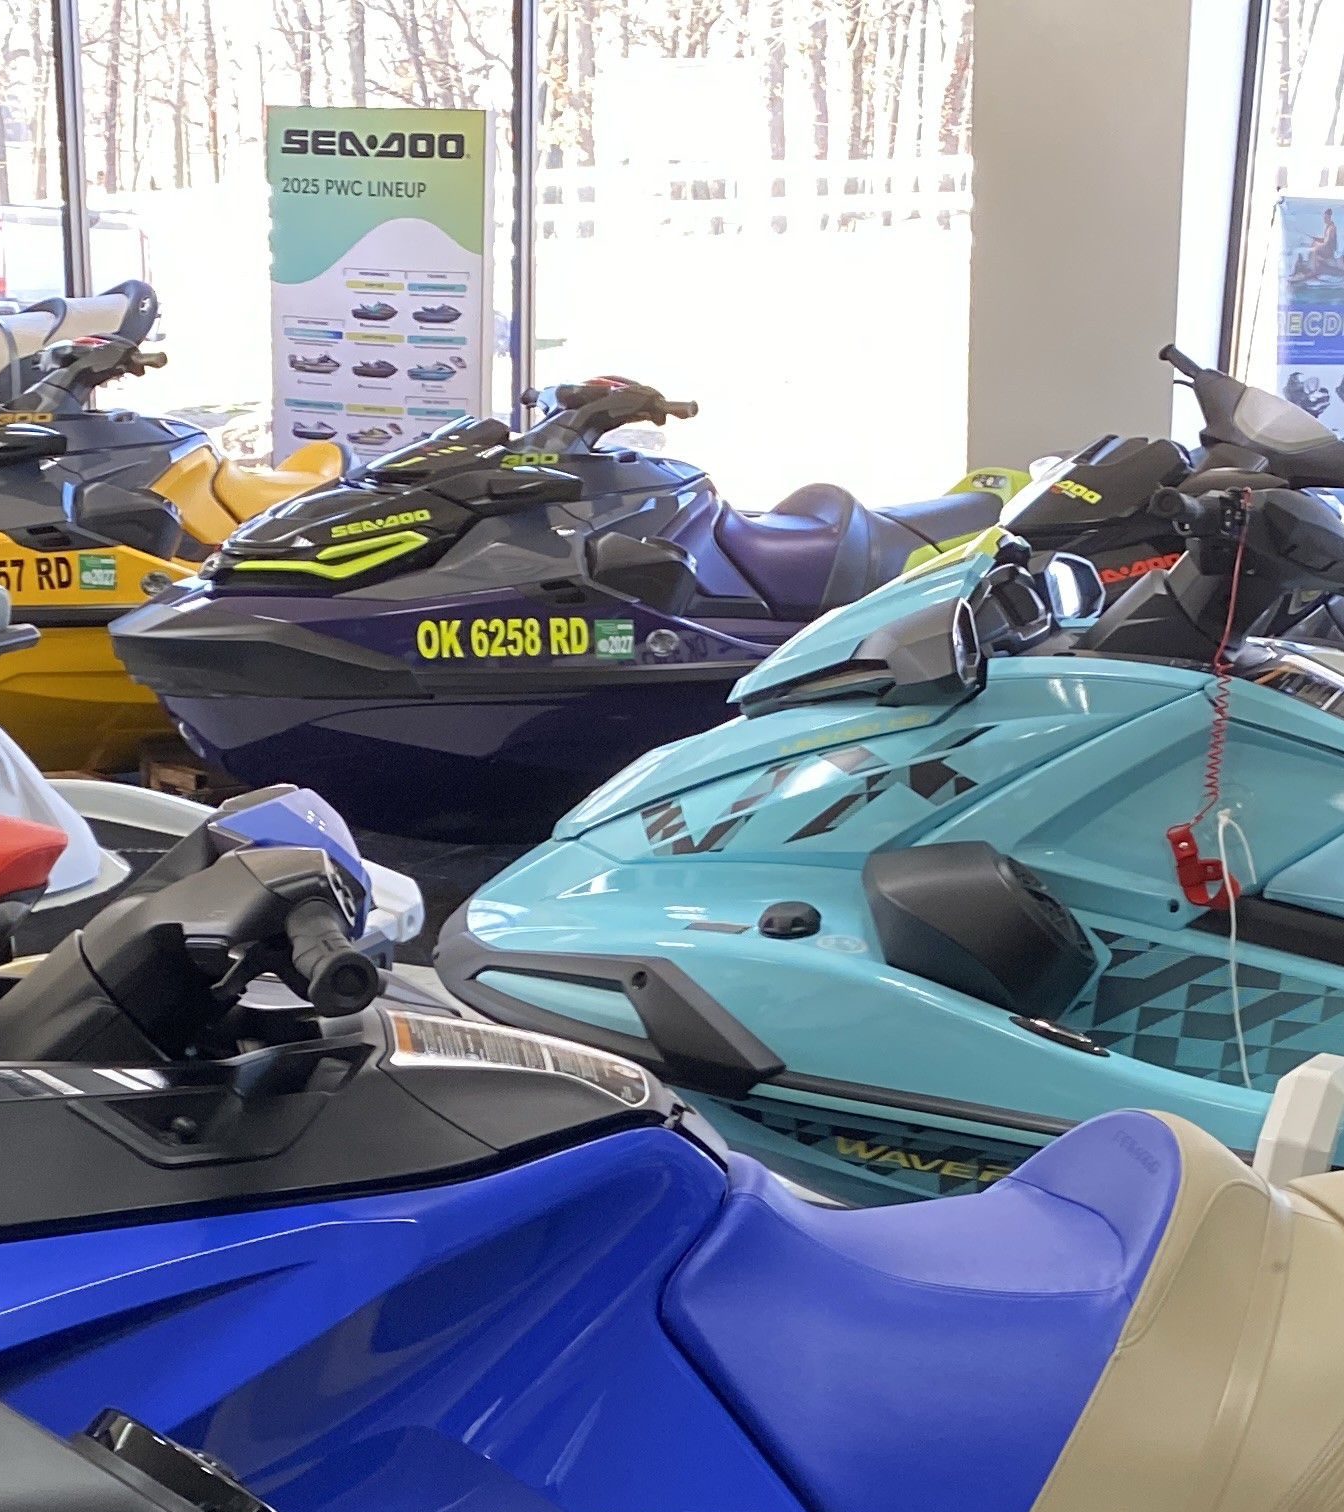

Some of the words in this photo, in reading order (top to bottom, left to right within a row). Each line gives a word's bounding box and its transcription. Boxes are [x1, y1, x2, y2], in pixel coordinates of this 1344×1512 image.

[281, 177, 320, 194] 2025
[325, 180, 363, 197] PWC
[367, 181, 427, 198] LINEUP
[35, 557, 72, 590] RD
[417, 620, 464, 659] OK
[471, 618, 542, 657] 6258
[549, 617, 589, 655] RD
